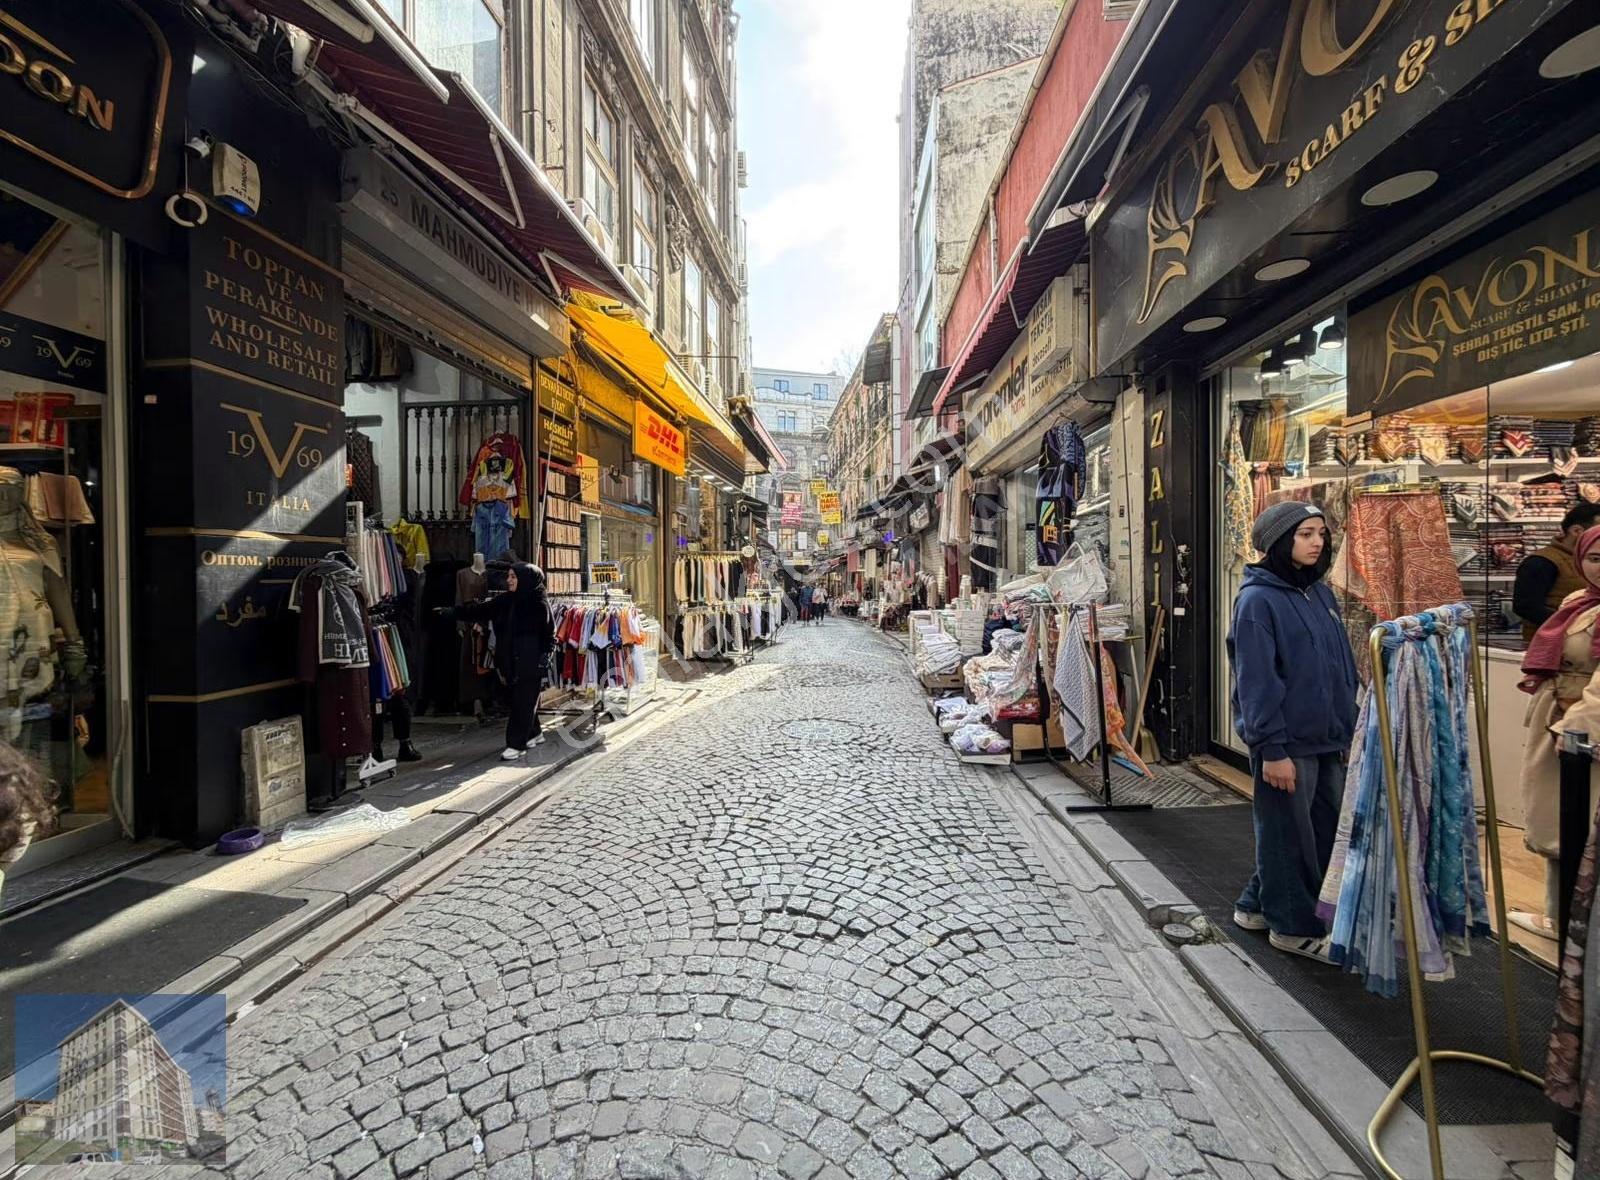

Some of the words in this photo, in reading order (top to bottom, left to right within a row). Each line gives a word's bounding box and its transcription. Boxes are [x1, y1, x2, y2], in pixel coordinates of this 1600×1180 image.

[1285, 74, 1388, 188] SCARF
[1395, 35, 1436, 93] &
[223, 235, 324, 303] TOPTAN
[265, 277, 292, 304] VE
[204, 270, 338, 342] PERAKENDE
[1547, 300, 1582, 323] SAN.
[205, 305, 338, 370] WHOLESALE
[209, 330, 259, 359] AND
[267, 349, 337, 386] RETAIL
[648, 415, 679, 454] DHL
[247, 489, 311, 513] ITALIA
[594, 572, 611, 583] 100
